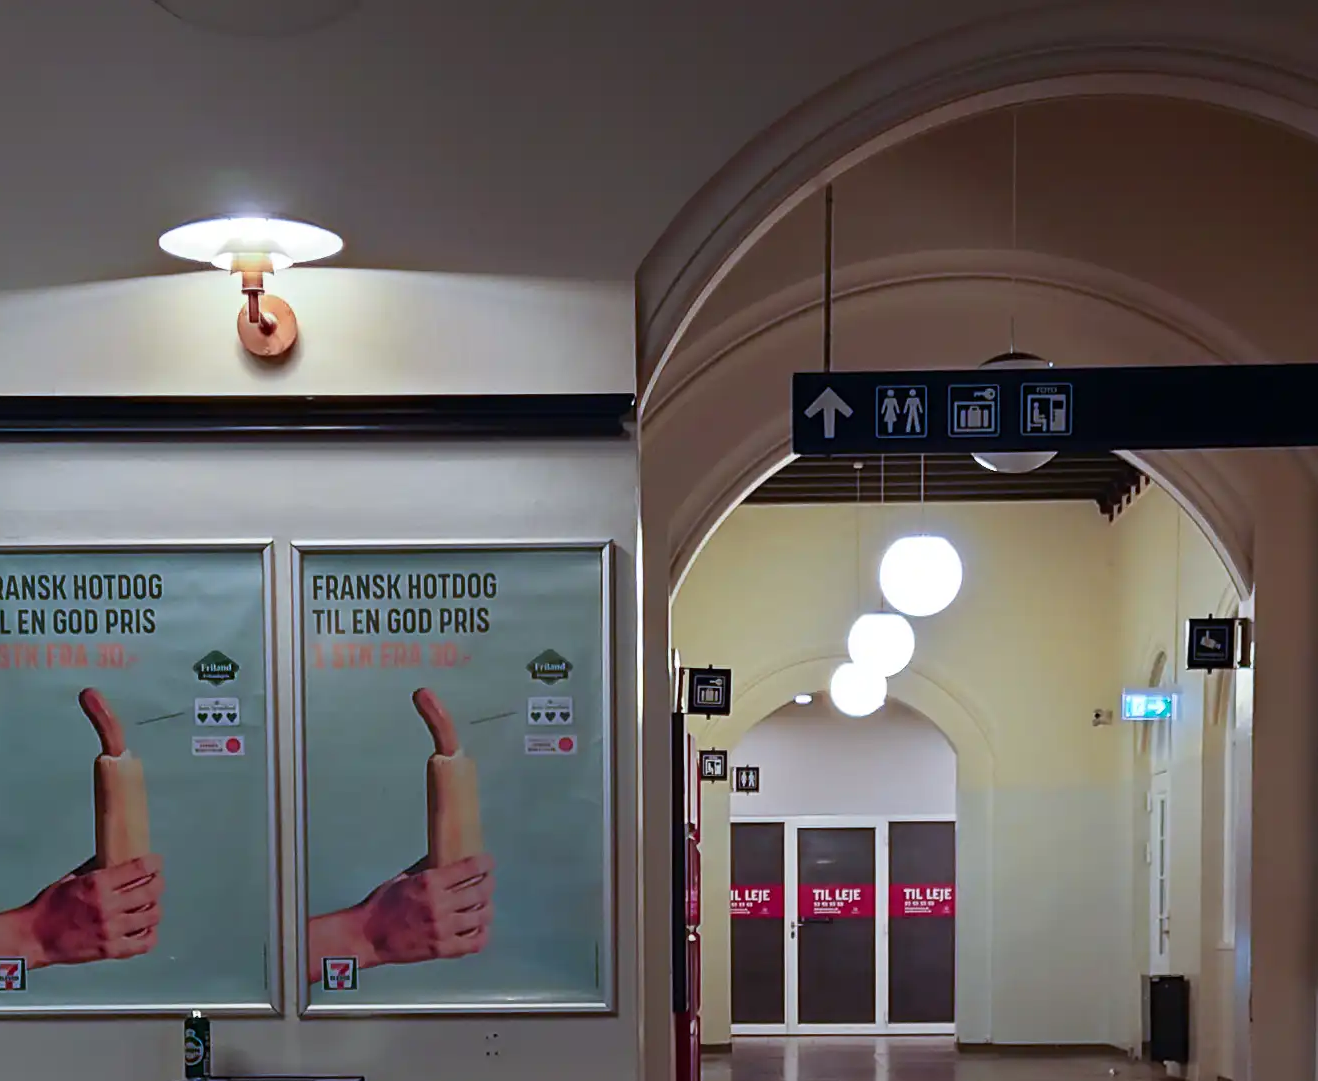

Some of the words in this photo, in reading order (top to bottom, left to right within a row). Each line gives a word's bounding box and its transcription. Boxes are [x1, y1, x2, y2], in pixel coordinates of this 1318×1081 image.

[74, 573, 163, 600] HOTDOG
[312, 573, 402, 600] FRANSK
[408, 572, 497, 599] HOTDOG
[18, 609, 45, 634] EN
[53, 608, 98, 634] GOD
[105, 608, 156, 634] PRIS
[312, 609, 345, 635] TIL
[352, 609, 380, 634] EN
[387, 608, 432, 634] GOD
[439, 607, 490, 633] PRIS
[730, 889, 742, 901] IL
[744, 889, 771, 903] LEJE
[812, 889, 833, 901] TIL
[835, 889, 861, 903] LEJE
[903, 888, 923, 900] TIL
[926, 888, 952, 902] LEJE
